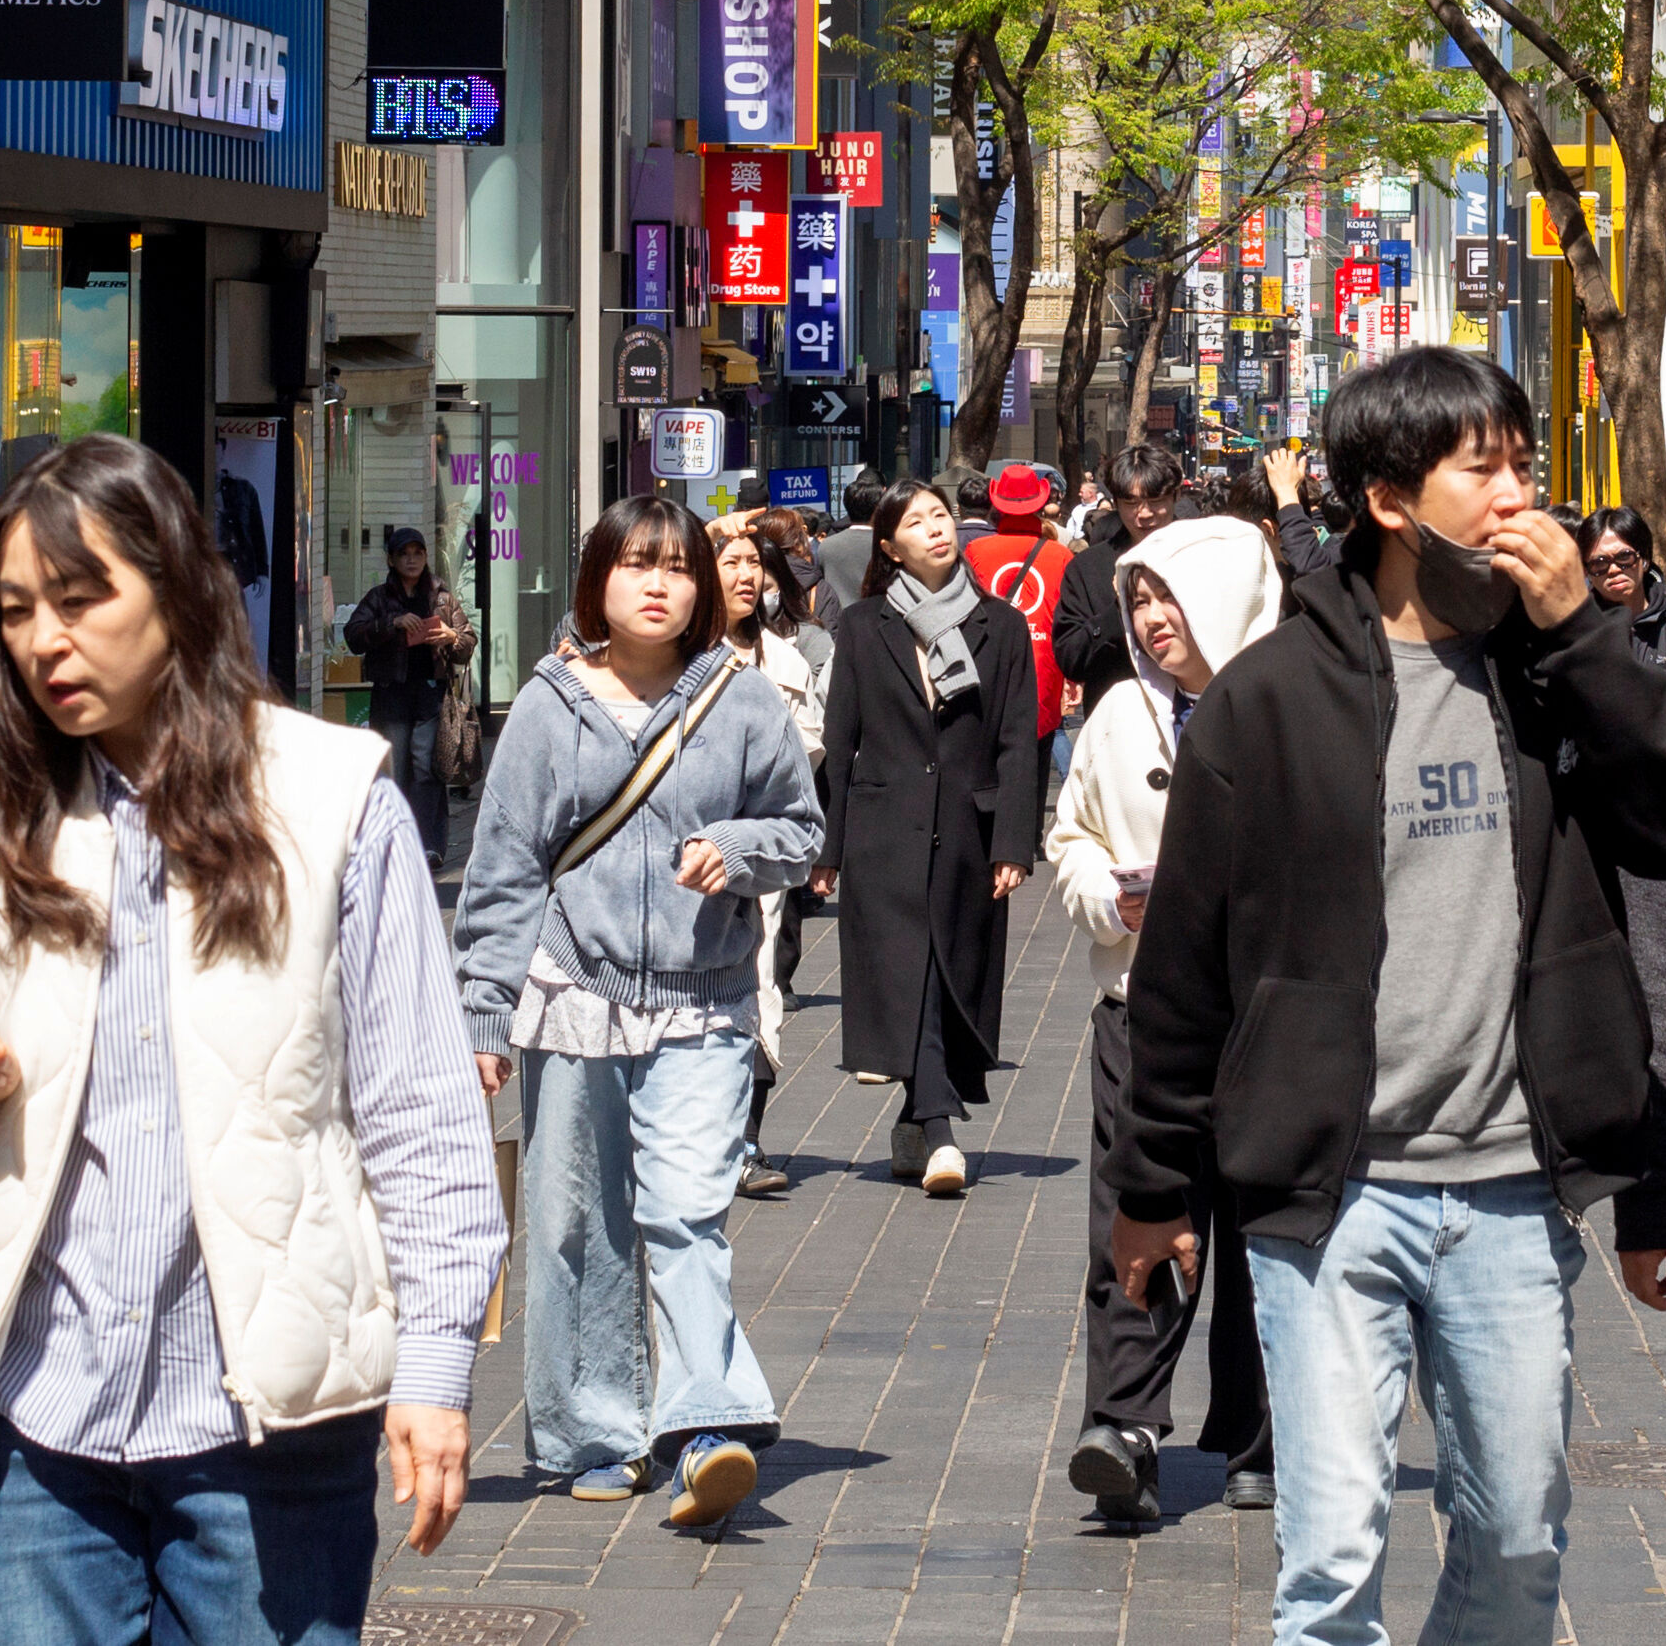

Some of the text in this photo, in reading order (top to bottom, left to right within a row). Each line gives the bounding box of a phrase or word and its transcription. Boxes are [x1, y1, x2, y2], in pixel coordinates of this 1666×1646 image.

[815, 141, 875, 158] JUNO
[821, 158, 868, 175] HAIR
[340, 140, 428, 218] NATURE REPUBLIC
[730, 160, 763, 193] 藥
[1467, 190, 1488, 235] ML
[796, 211, 836, 251] 藥
[1346, 220, 1378, 230] KOREA
[1361, 230, 1378, 239] SPA
[645, 228, 658, 271] VAPE
[728, 243, 763, 278] 药
[85, 279, 128, 289] CHERS
[709, 283, 781, 297] Drug Store
[1383, 321, 1408, 333] dao
[796, 319, 834, 363] 약
[630, 366, 657, 377] SW19
[1002, 354, 1016, 419] TUDE
[256, 422, 276, 438] B1
[664, 420, 706, 435] VAPE
[797, 425, 862, 435] CONVERSE
[450, 452, 541, 486] WECOME
[784, 475, 813, 489] TAX
[780, 488, 818, 500] REFUND
[465, 528, 524, 562] SOUL
[1418, 760, 1479, 812] 50
[1390, 801, 1419, 817] ATH.
[1406, 811, 1498, 840] AMERICAN
